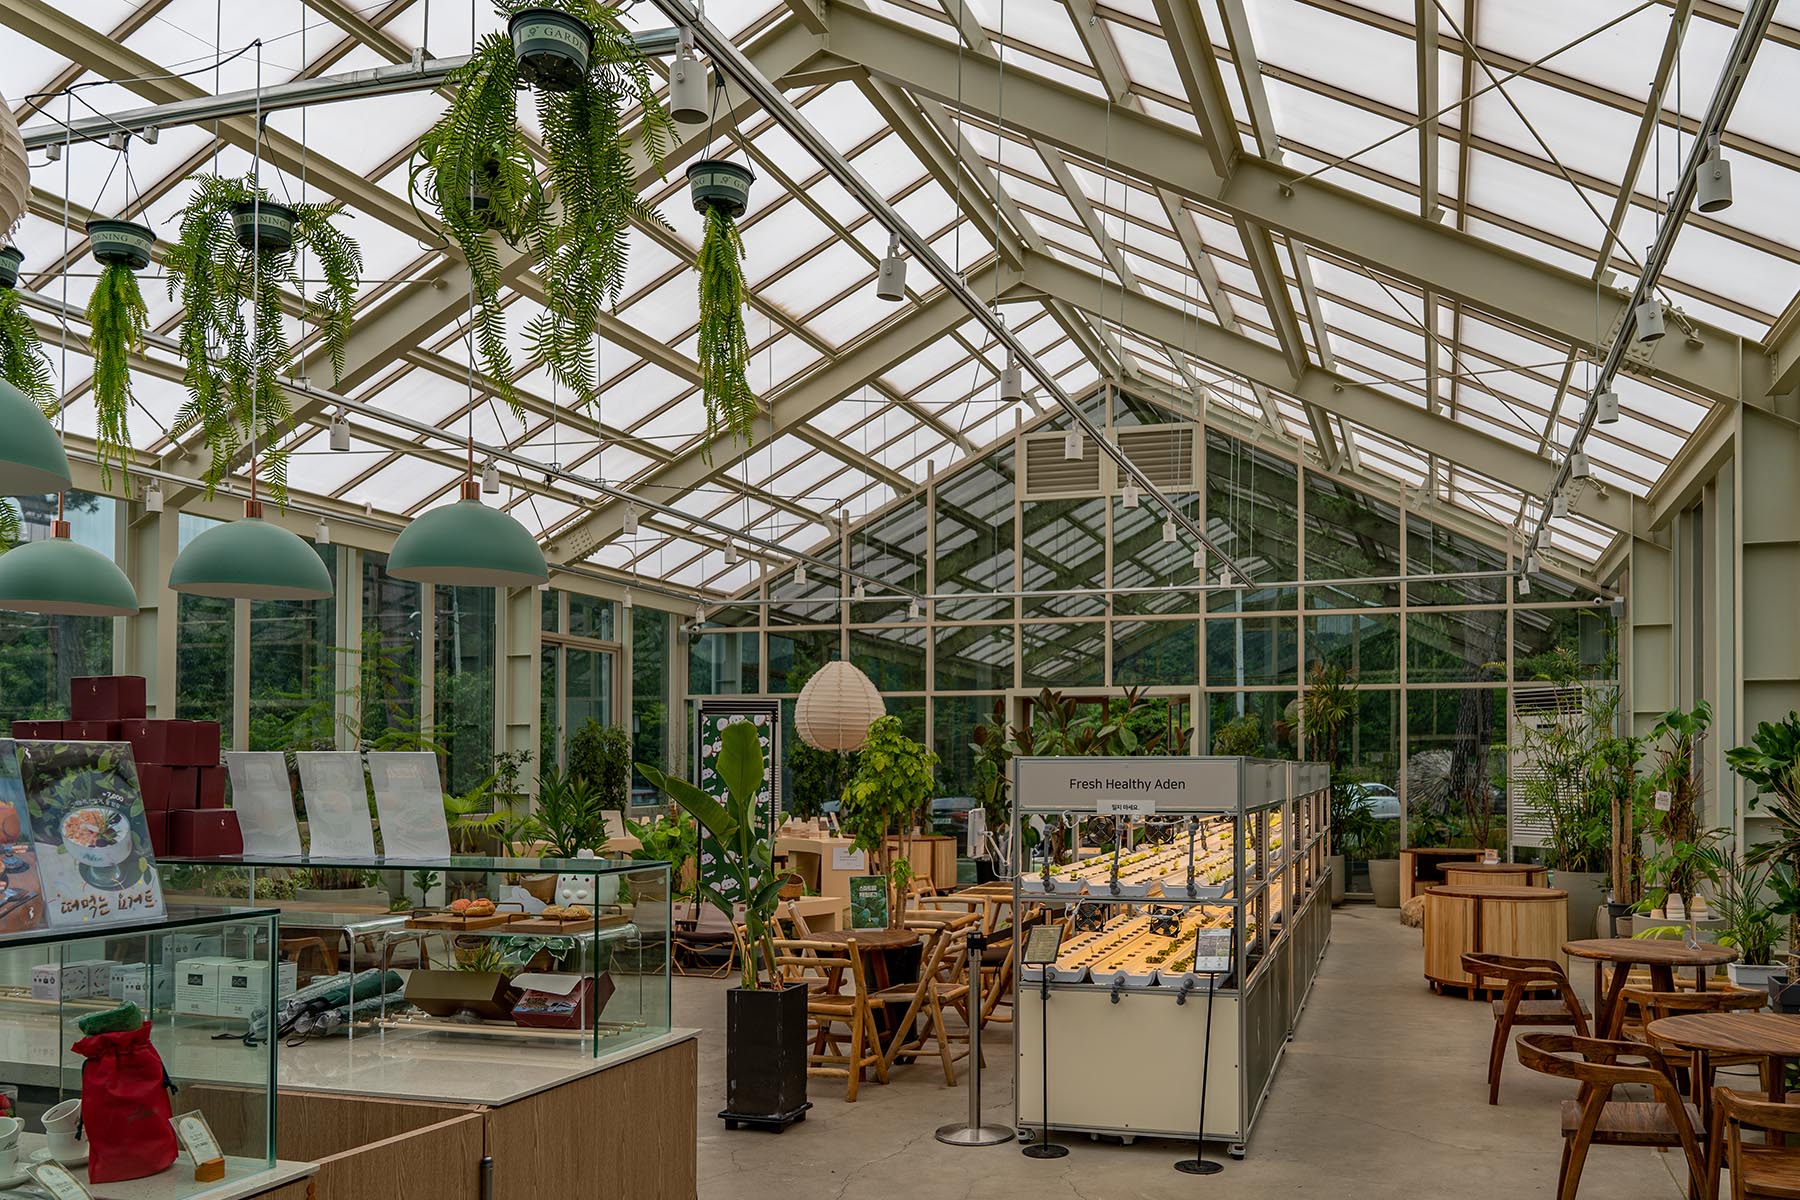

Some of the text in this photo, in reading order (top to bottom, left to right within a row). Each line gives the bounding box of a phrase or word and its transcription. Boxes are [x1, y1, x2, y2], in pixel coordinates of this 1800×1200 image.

[1069, 778, 1186, 792] Fresh Healthy Aden
[61, 890, 155, 919] 떠먹는 요거트
